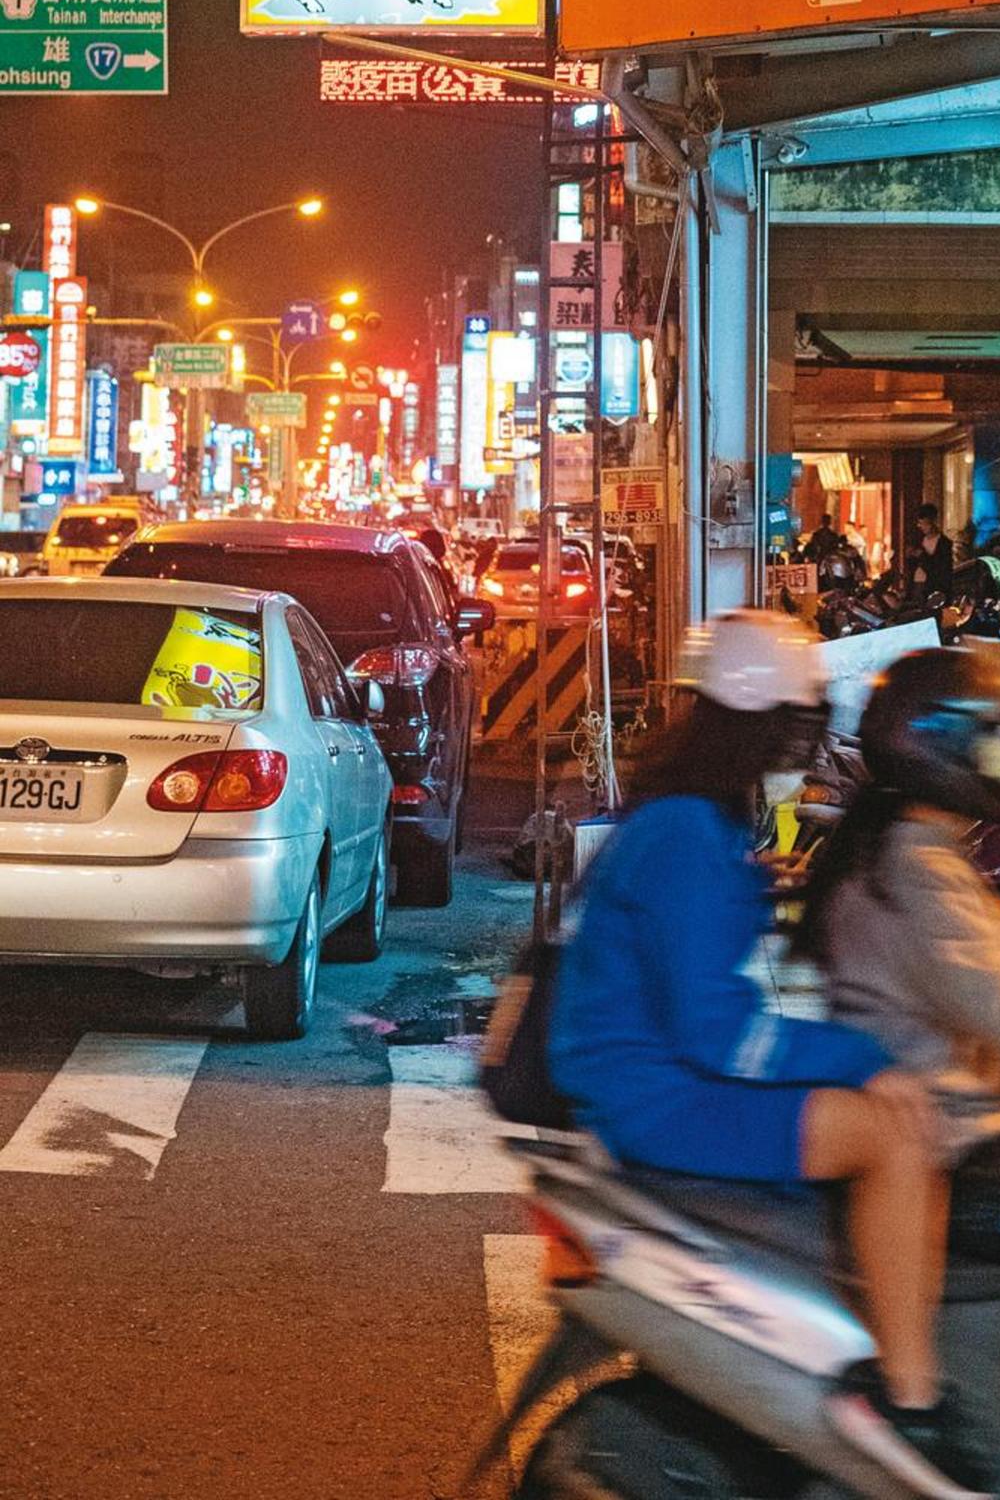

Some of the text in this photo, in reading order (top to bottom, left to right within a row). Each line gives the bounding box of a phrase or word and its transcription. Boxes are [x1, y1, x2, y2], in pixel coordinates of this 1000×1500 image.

[48, 7, 162, 29] Tainan Interchange
[43, 36, 70, 63] 雄
[93, 50, 115, 67] 17
[171, 733, 222, 744] ALTIS
